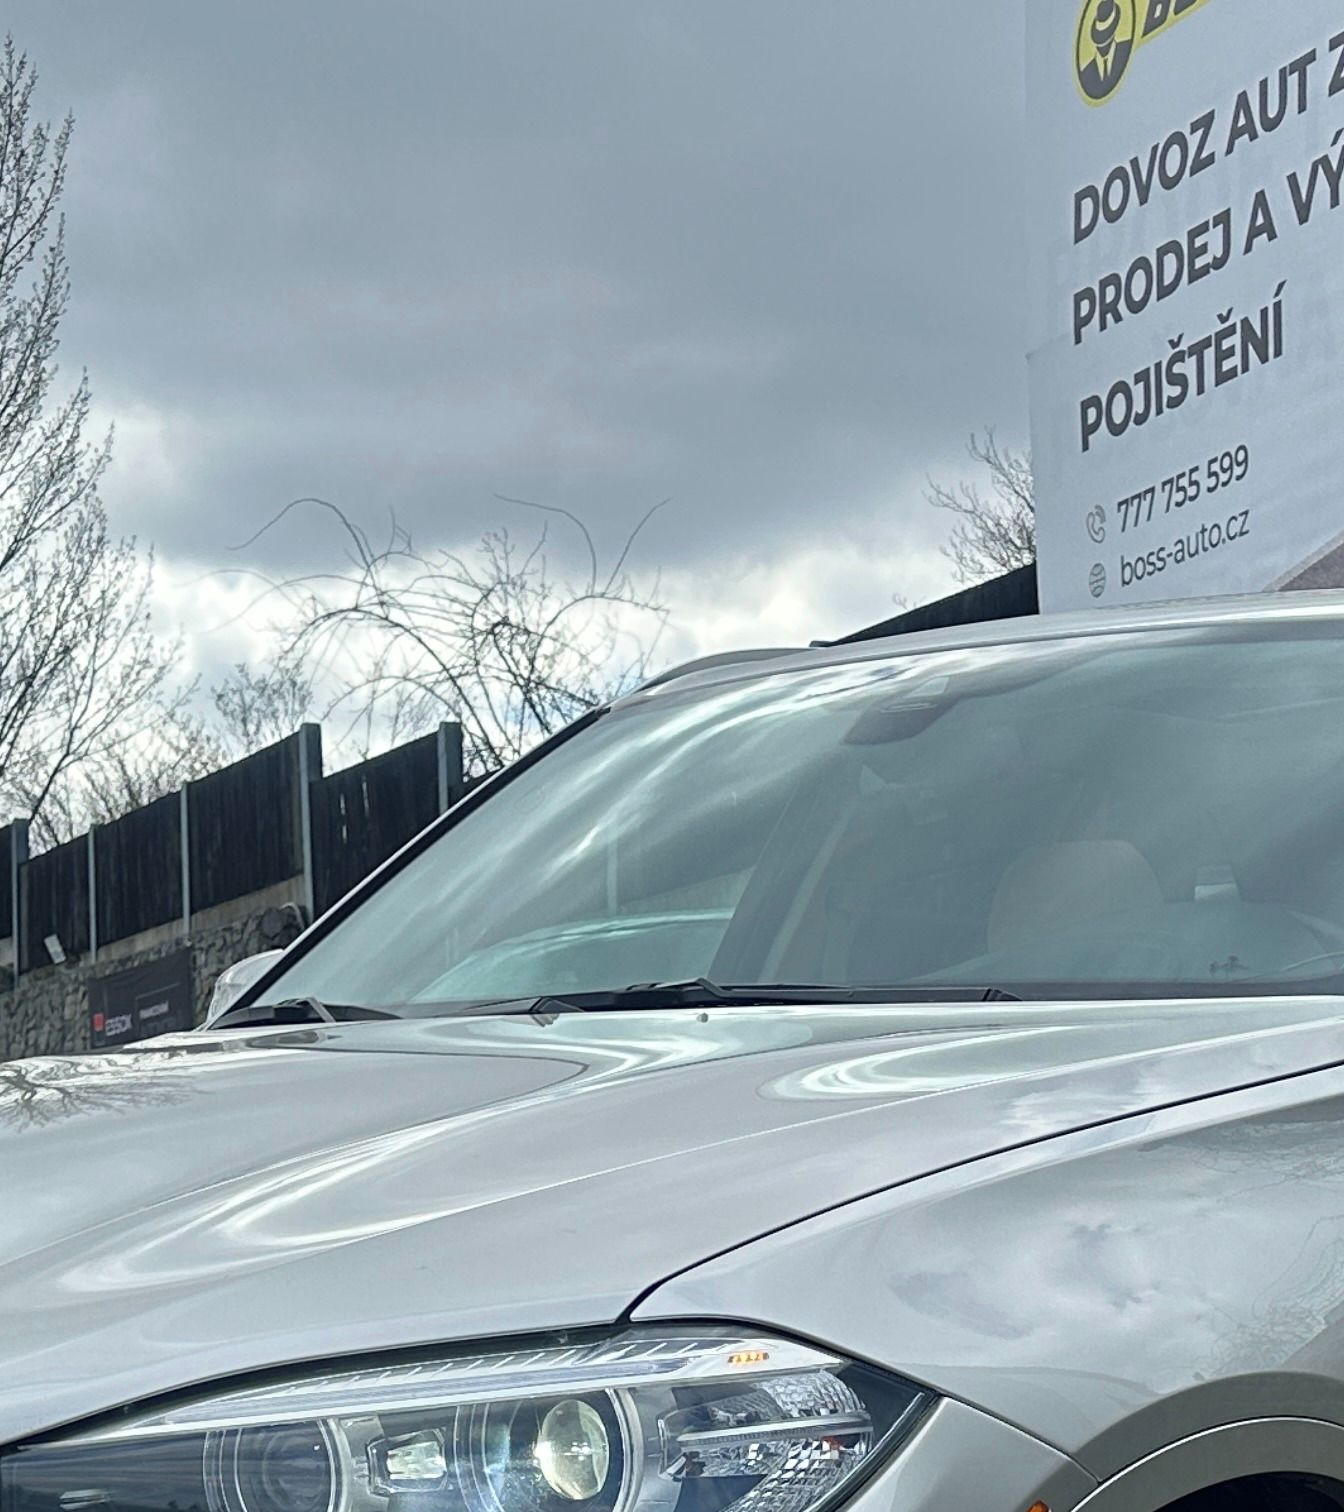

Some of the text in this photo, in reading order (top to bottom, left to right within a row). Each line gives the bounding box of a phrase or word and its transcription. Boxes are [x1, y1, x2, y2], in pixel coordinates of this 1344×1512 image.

[1074, 108, 1216, 245] DOVOZ
[1225, 49, 1316, 156] AUT
[1073, 208, 1232, 346] PRODEJ
[1243, 190, 1278, 256] A
[1079, 279, 1289, 453] POJIŠTĚNÍ
[1117, 444, 1249, 533] 777 755 599
[1120, 509, 1251, 588] boss-auto.cz
